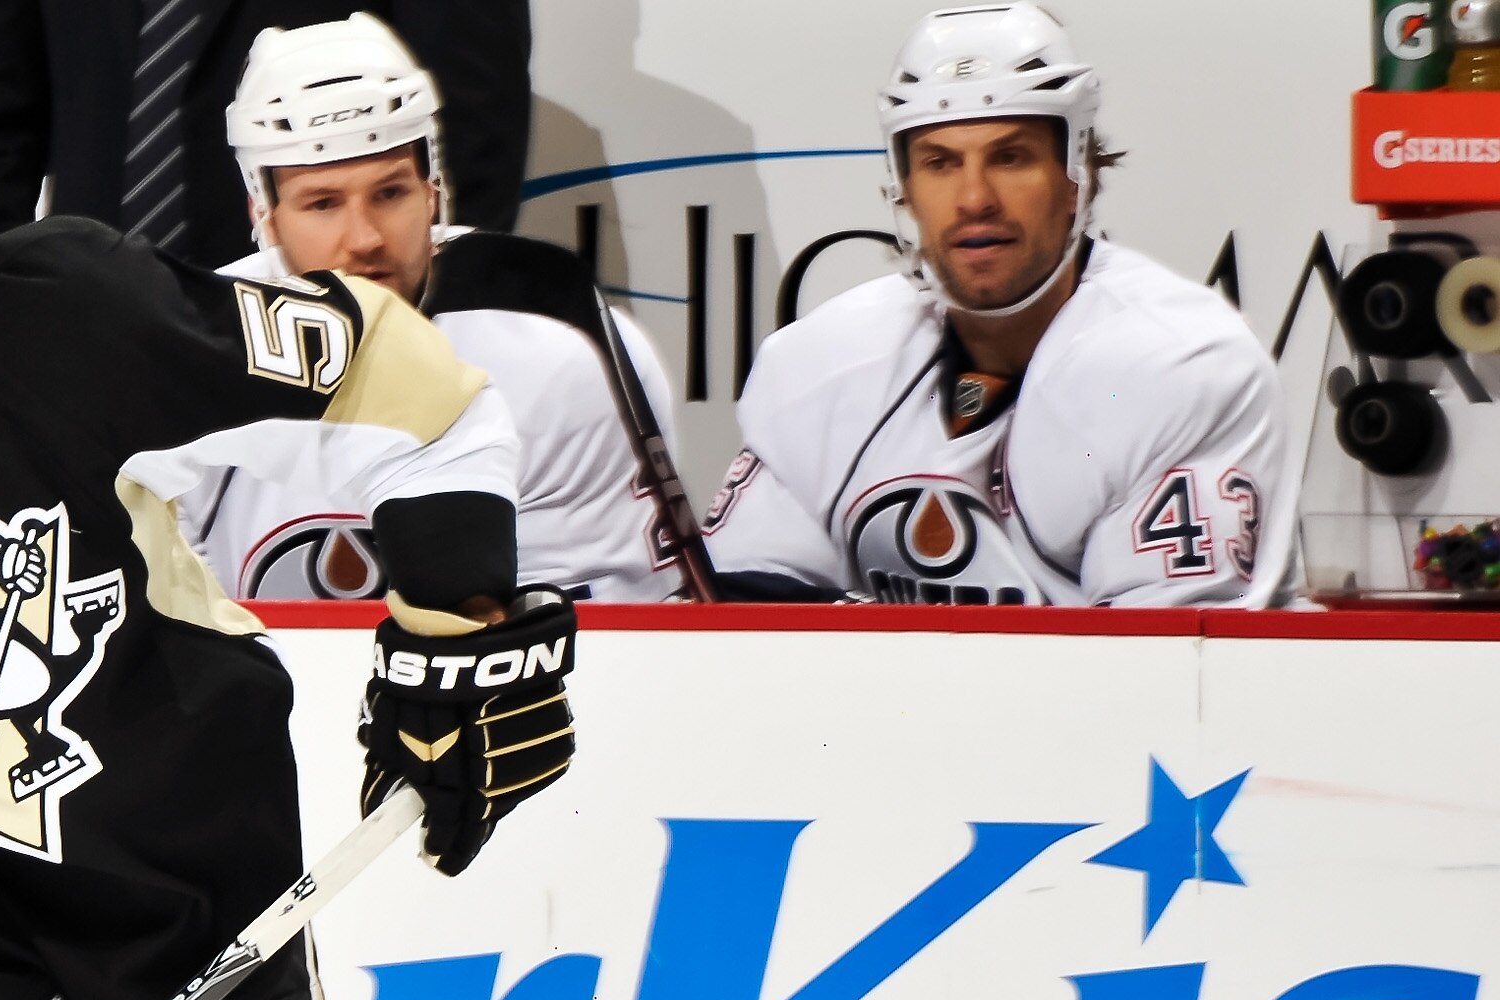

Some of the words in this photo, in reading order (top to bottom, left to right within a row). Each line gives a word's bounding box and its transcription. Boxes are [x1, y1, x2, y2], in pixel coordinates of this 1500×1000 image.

[1384, 3, 1434, 60] G
[308, 106, 374, 127] CCM
[233, 270, 355, 395] 5
[1131, 467, 1258, 583] 43
